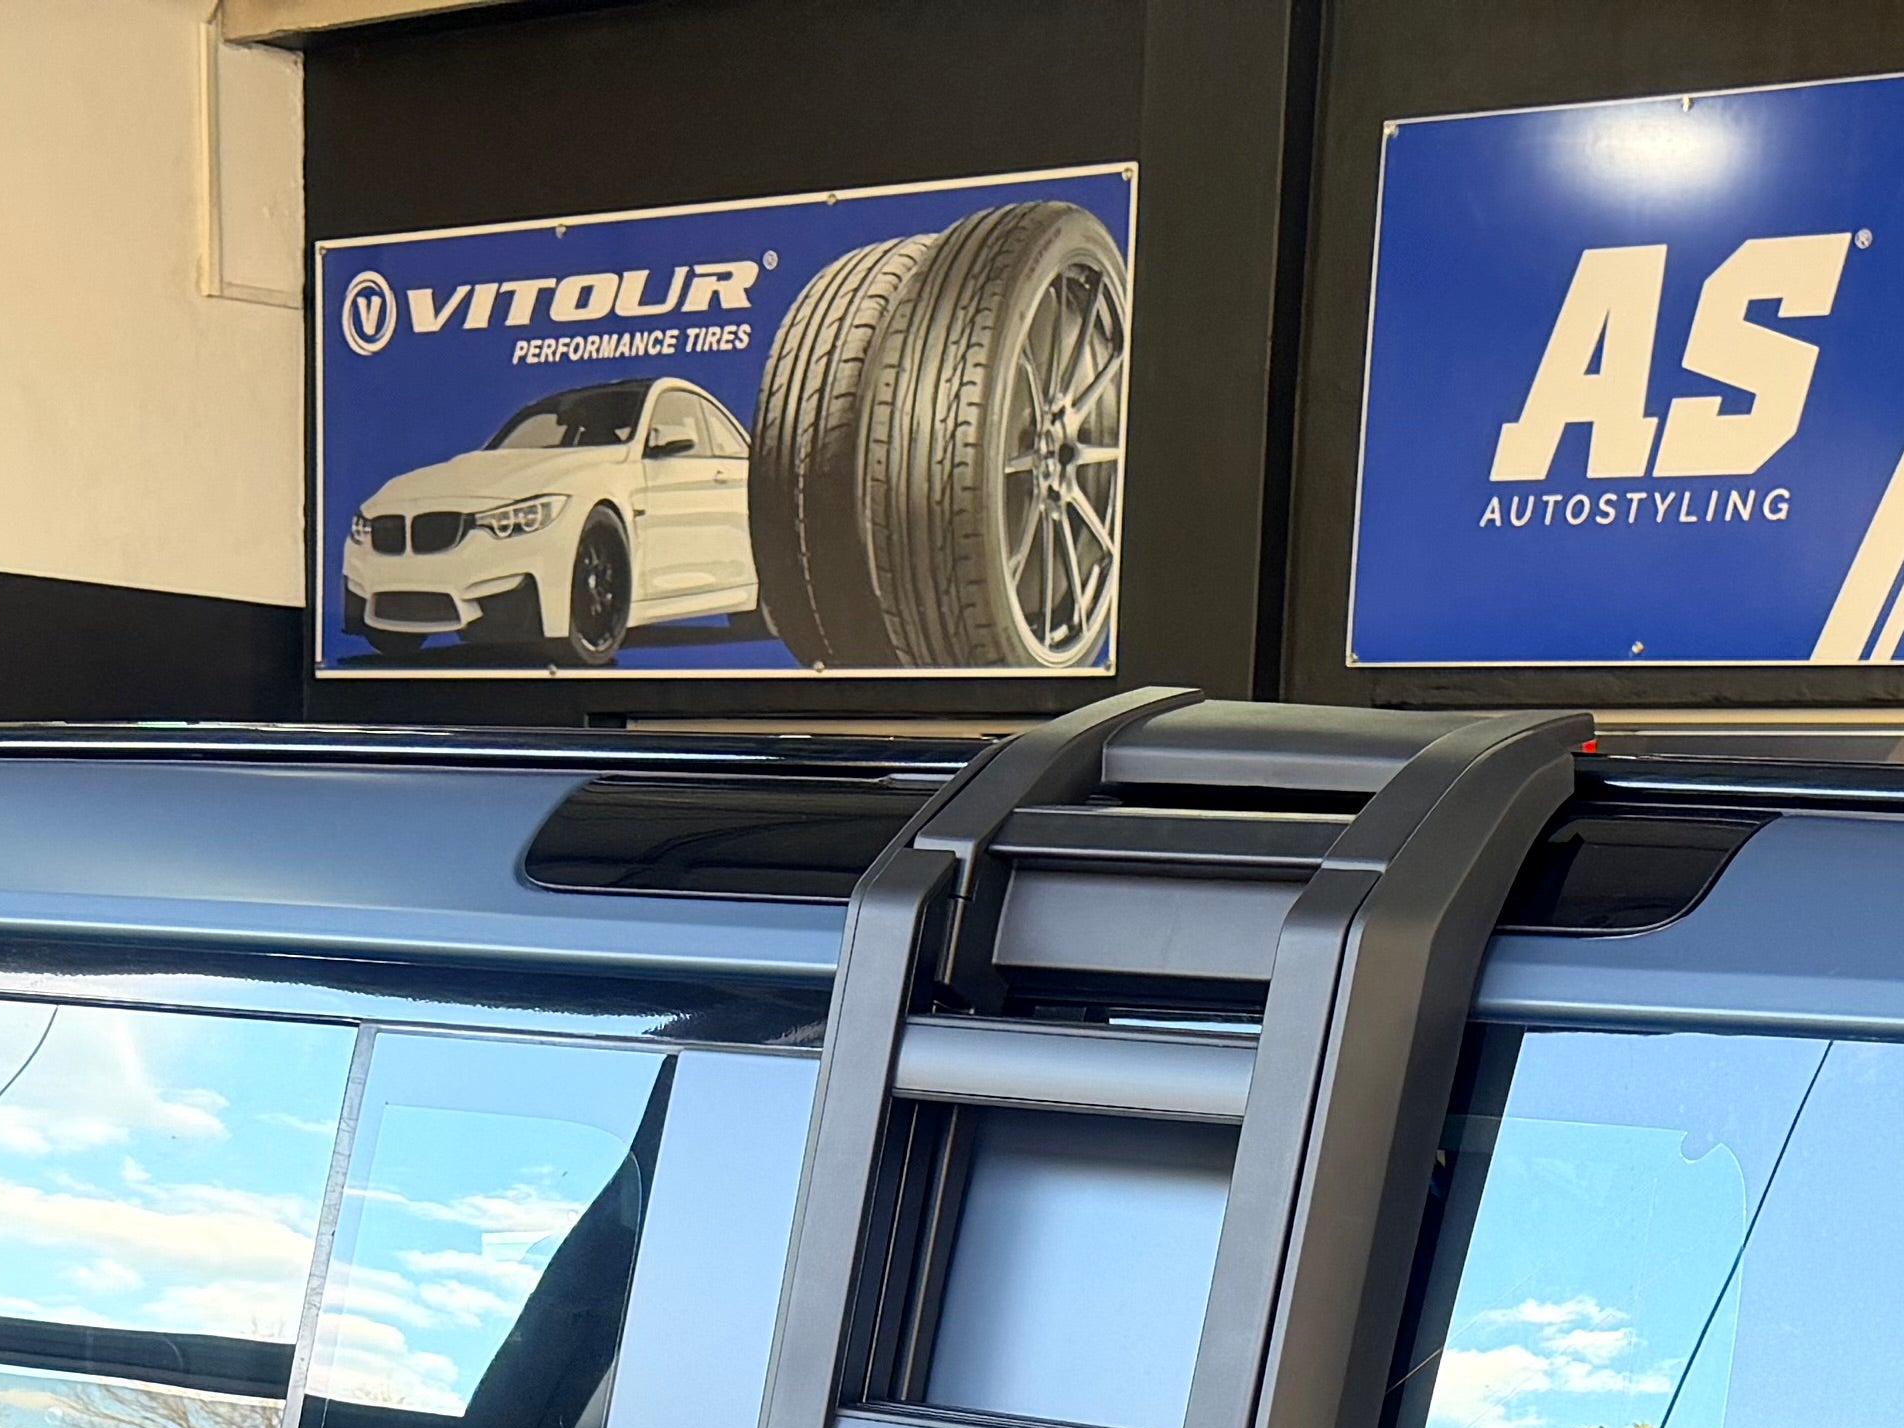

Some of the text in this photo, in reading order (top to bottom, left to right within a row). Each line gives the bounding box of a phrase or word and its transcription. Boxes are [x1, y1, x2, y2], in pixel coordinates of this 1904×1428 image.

[406, 260, 761, 334] VITOUR
[512, 324, 753, 365] PERFORMANCE TIRES
[1488, 231, 1853, 481] AS
[1478, 487, 1792, 529] AUTOSTYLING
